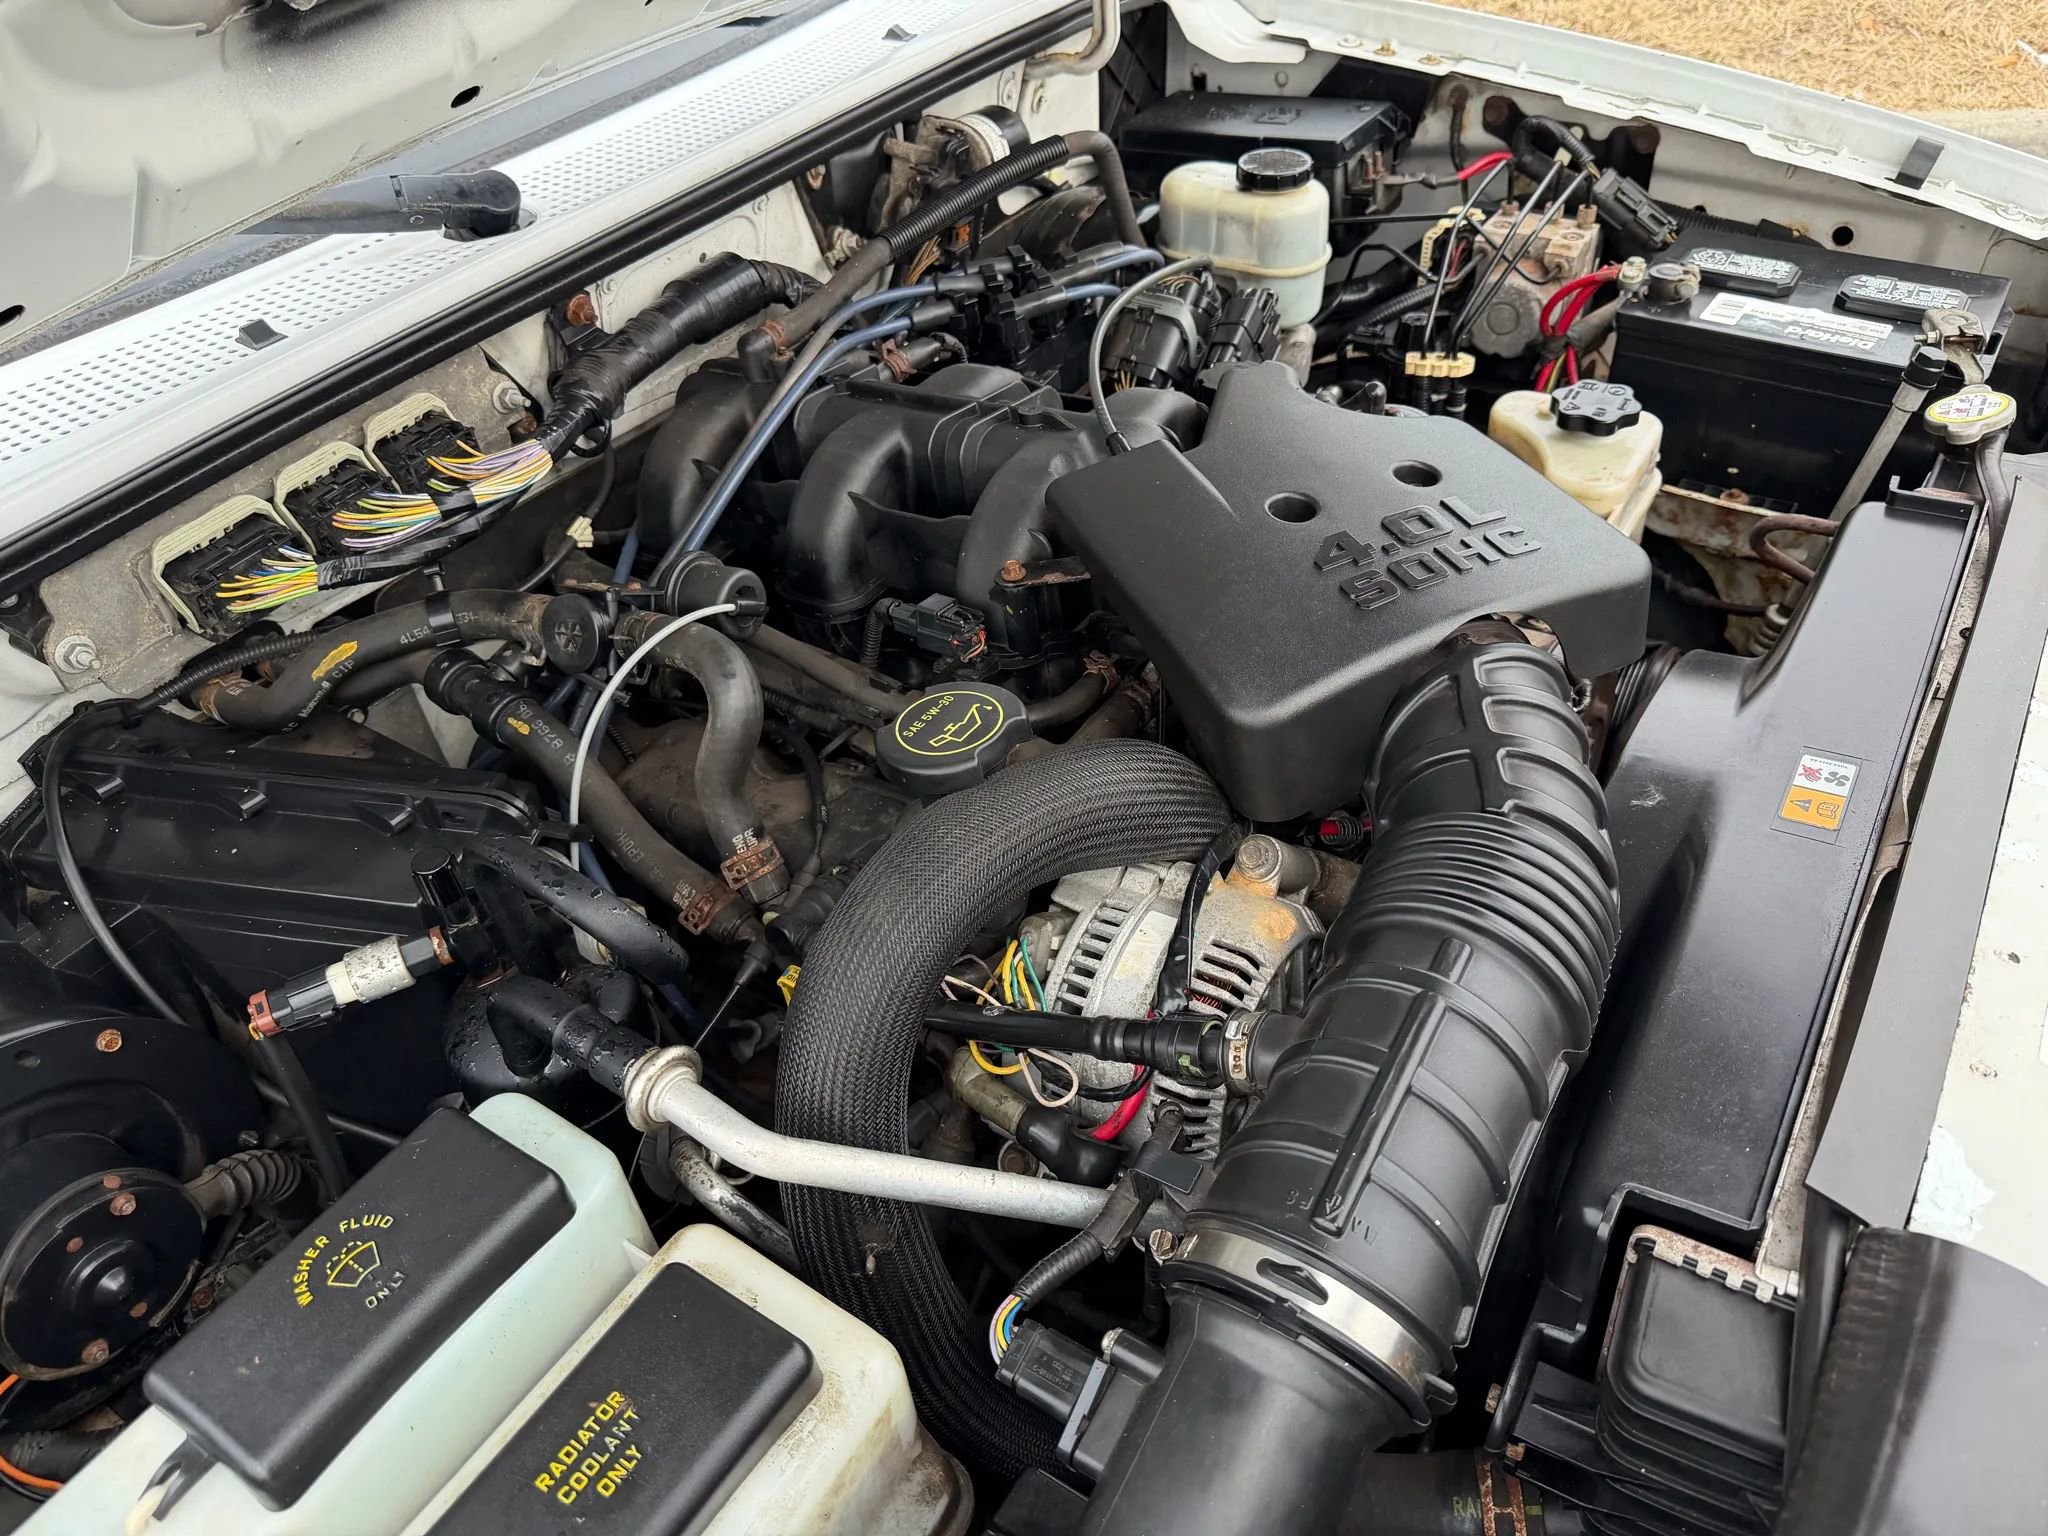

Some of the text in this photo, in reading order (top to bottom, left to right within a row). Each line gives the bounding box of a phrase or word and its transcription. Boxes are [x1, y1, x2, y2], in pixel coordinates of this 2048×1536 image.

[1783, 325, 1876, 350] DieHard
[1314, 496, 1507, 571] 4.0L
[1340, 525, 1542, 609] SOHC
[903, 694, 954, 738] SAE 5W-30
[732, 833, 747, 854] ENG
[744, 827, 758, 849] UPR
[293, 1214, 394, 1307] WASHER FLUID
[365, 1271, 406, 1309] ONLY
[534, 1391, 626, 1493] RADIATOR
[556, 1407, 640, 1505] COOLANT
[596, 1444, 642, 1497] ONLY
[1452, 1496, 1481, 1519] RA
